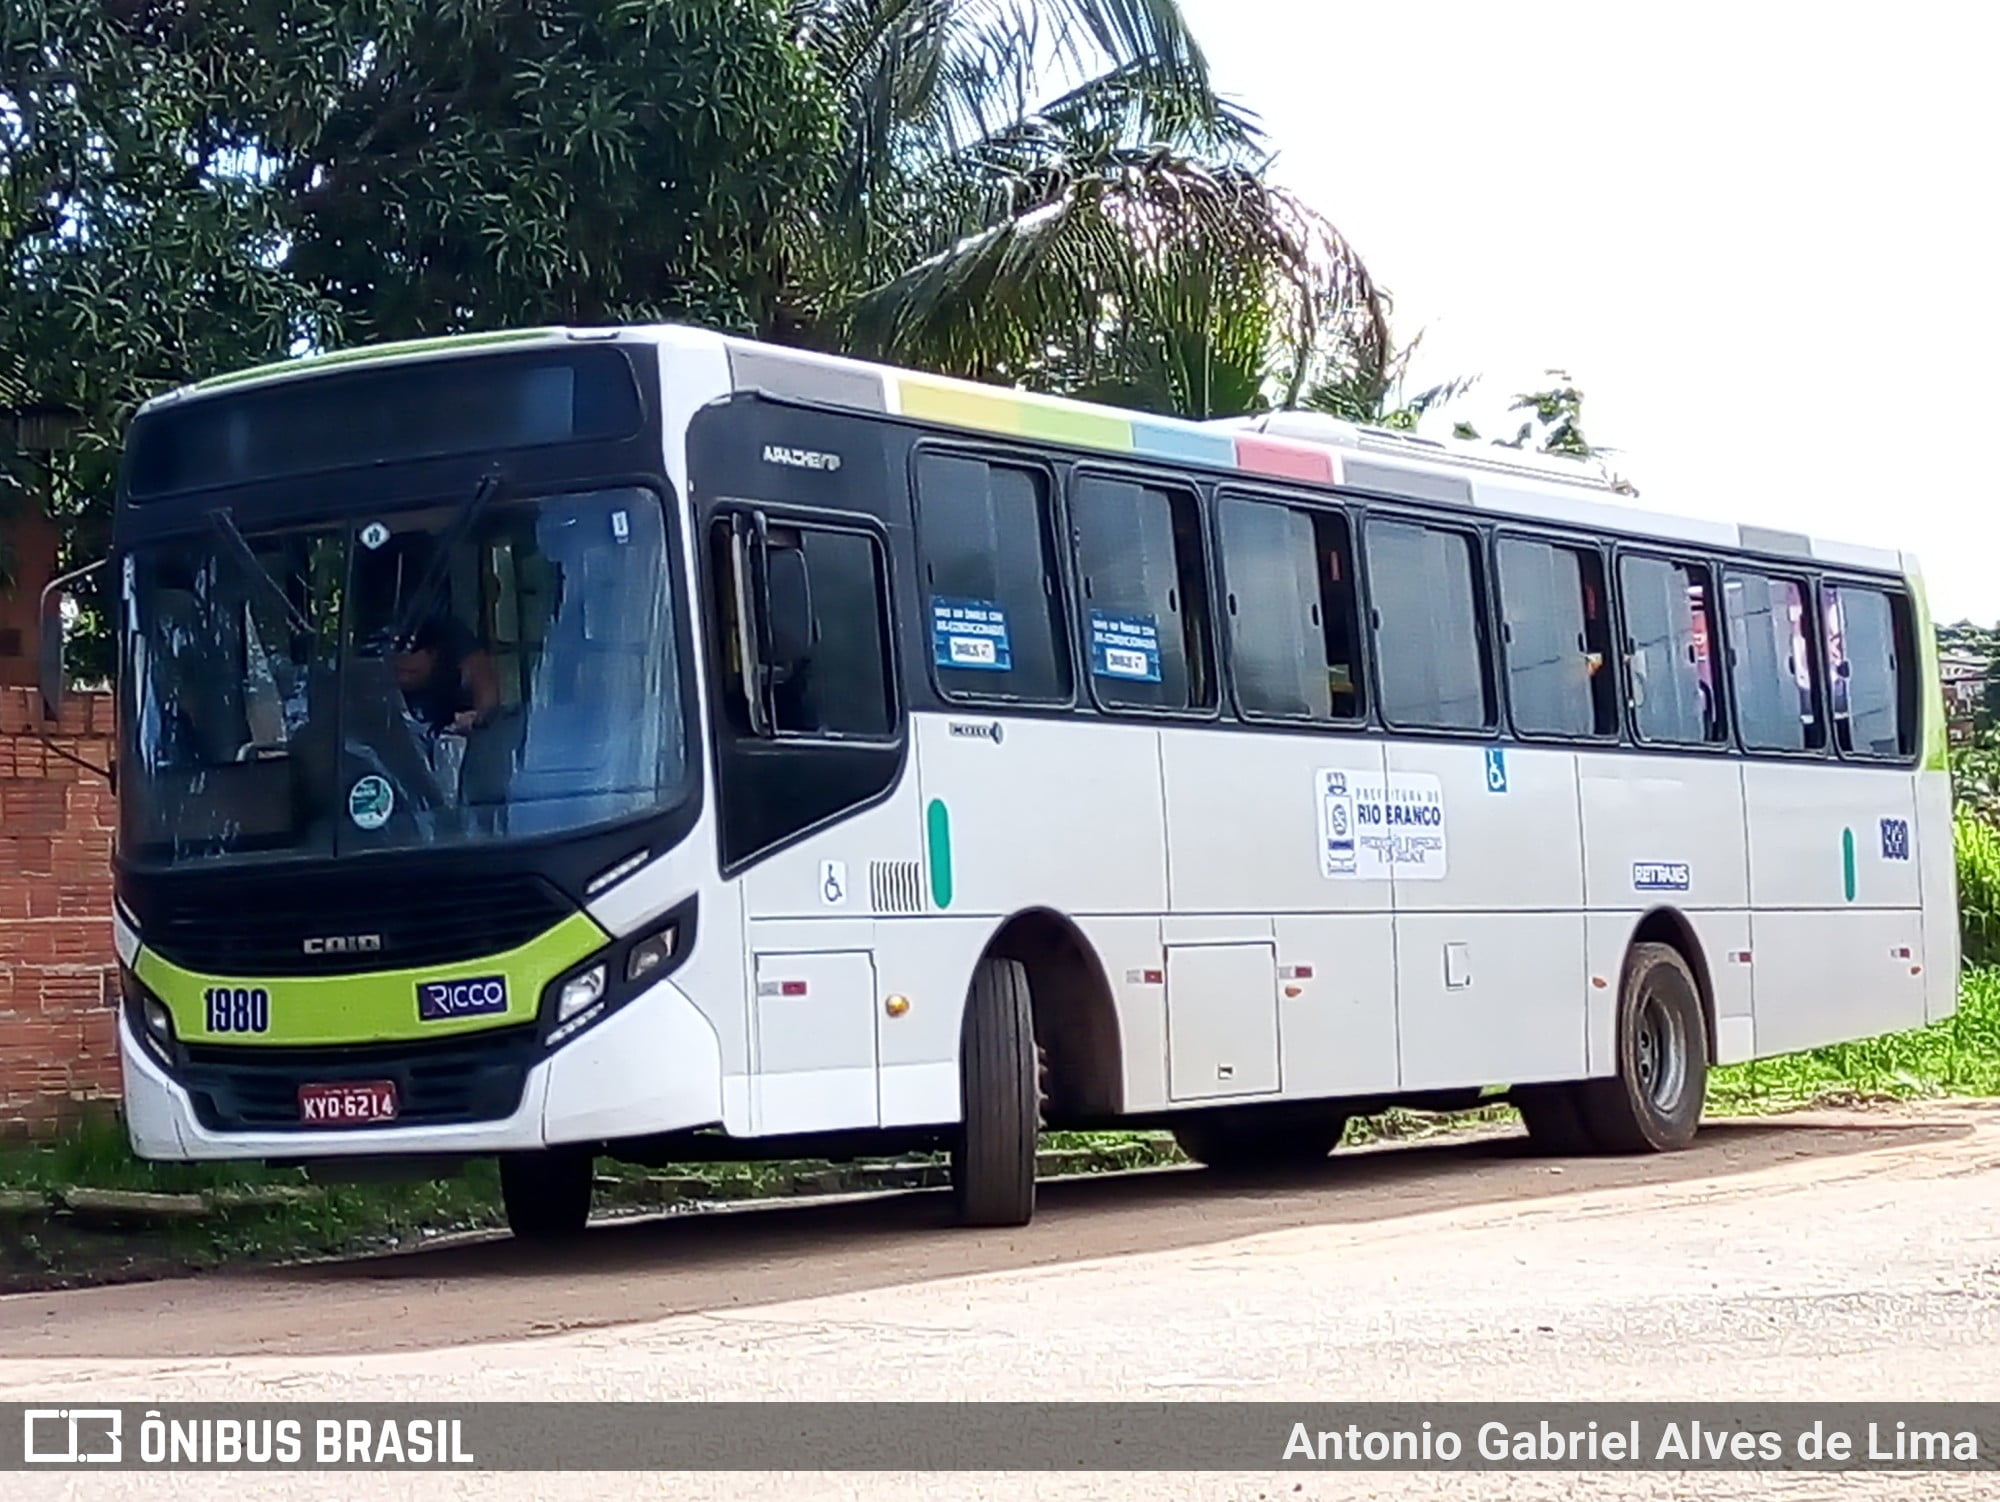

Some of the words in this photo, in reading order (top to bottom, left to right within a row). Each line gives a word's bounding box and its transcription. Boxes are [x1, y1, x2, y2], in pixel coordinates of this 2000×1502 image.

[1357, 803, 1381, 825] RIO
[204, 988, 268, 1032] 1980
[423, 981, 503, 1016] RICCO
